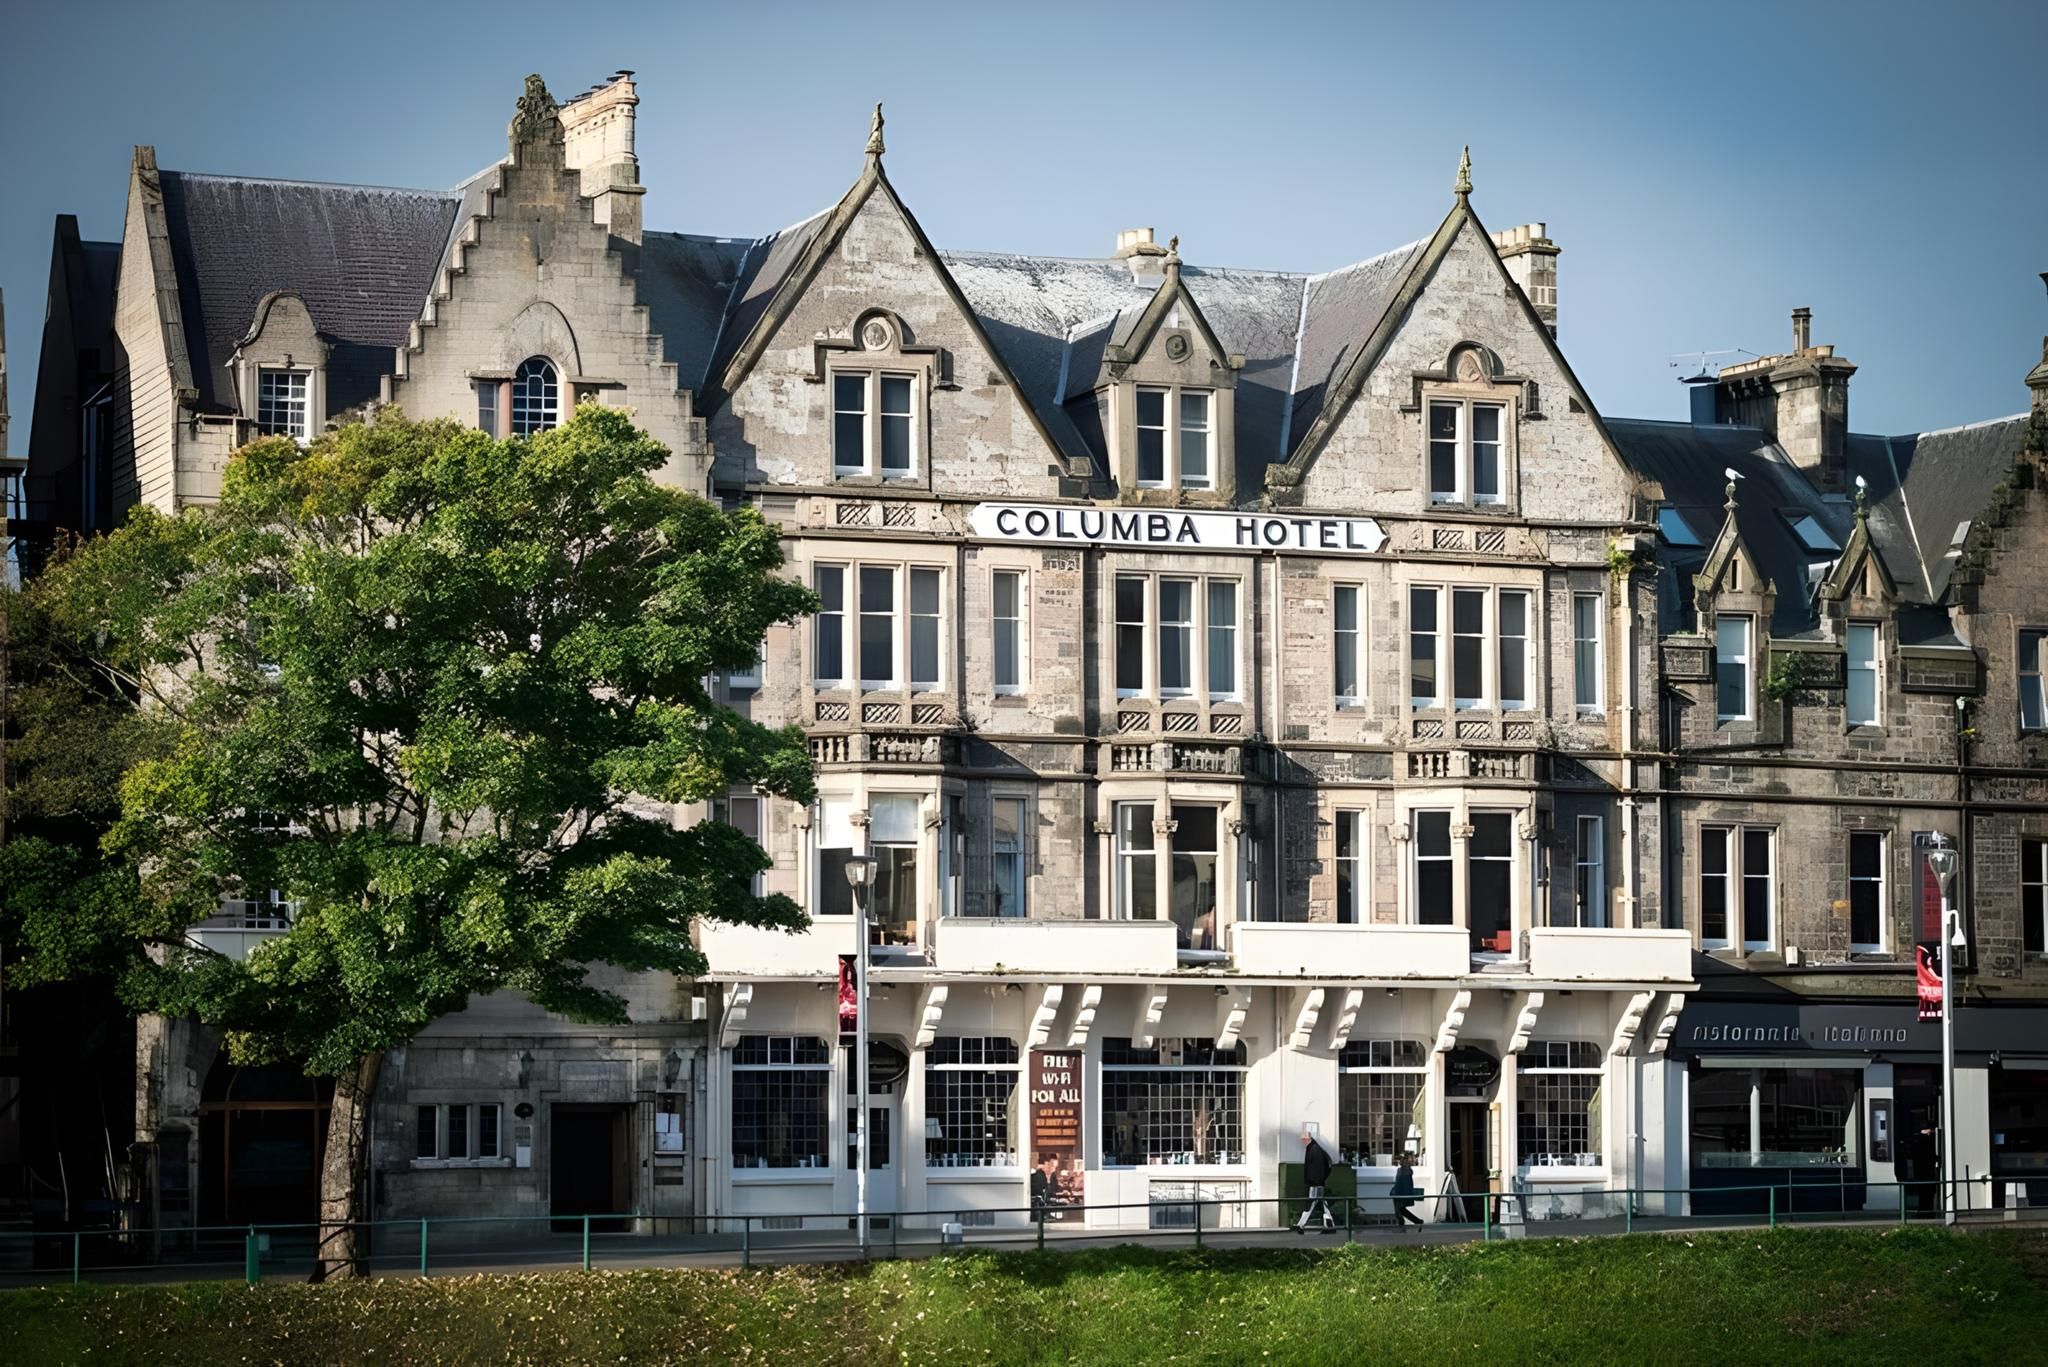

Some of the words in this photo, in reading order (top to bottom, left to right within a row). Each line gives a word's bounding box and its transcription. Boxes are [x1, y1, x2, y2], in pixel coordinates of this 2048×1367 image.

[996, 508, 1201, 545] COLUMBA
[1236, 517, 1368, 550] HOTEL
[1059, 1089, 1081, 1104] ALL
